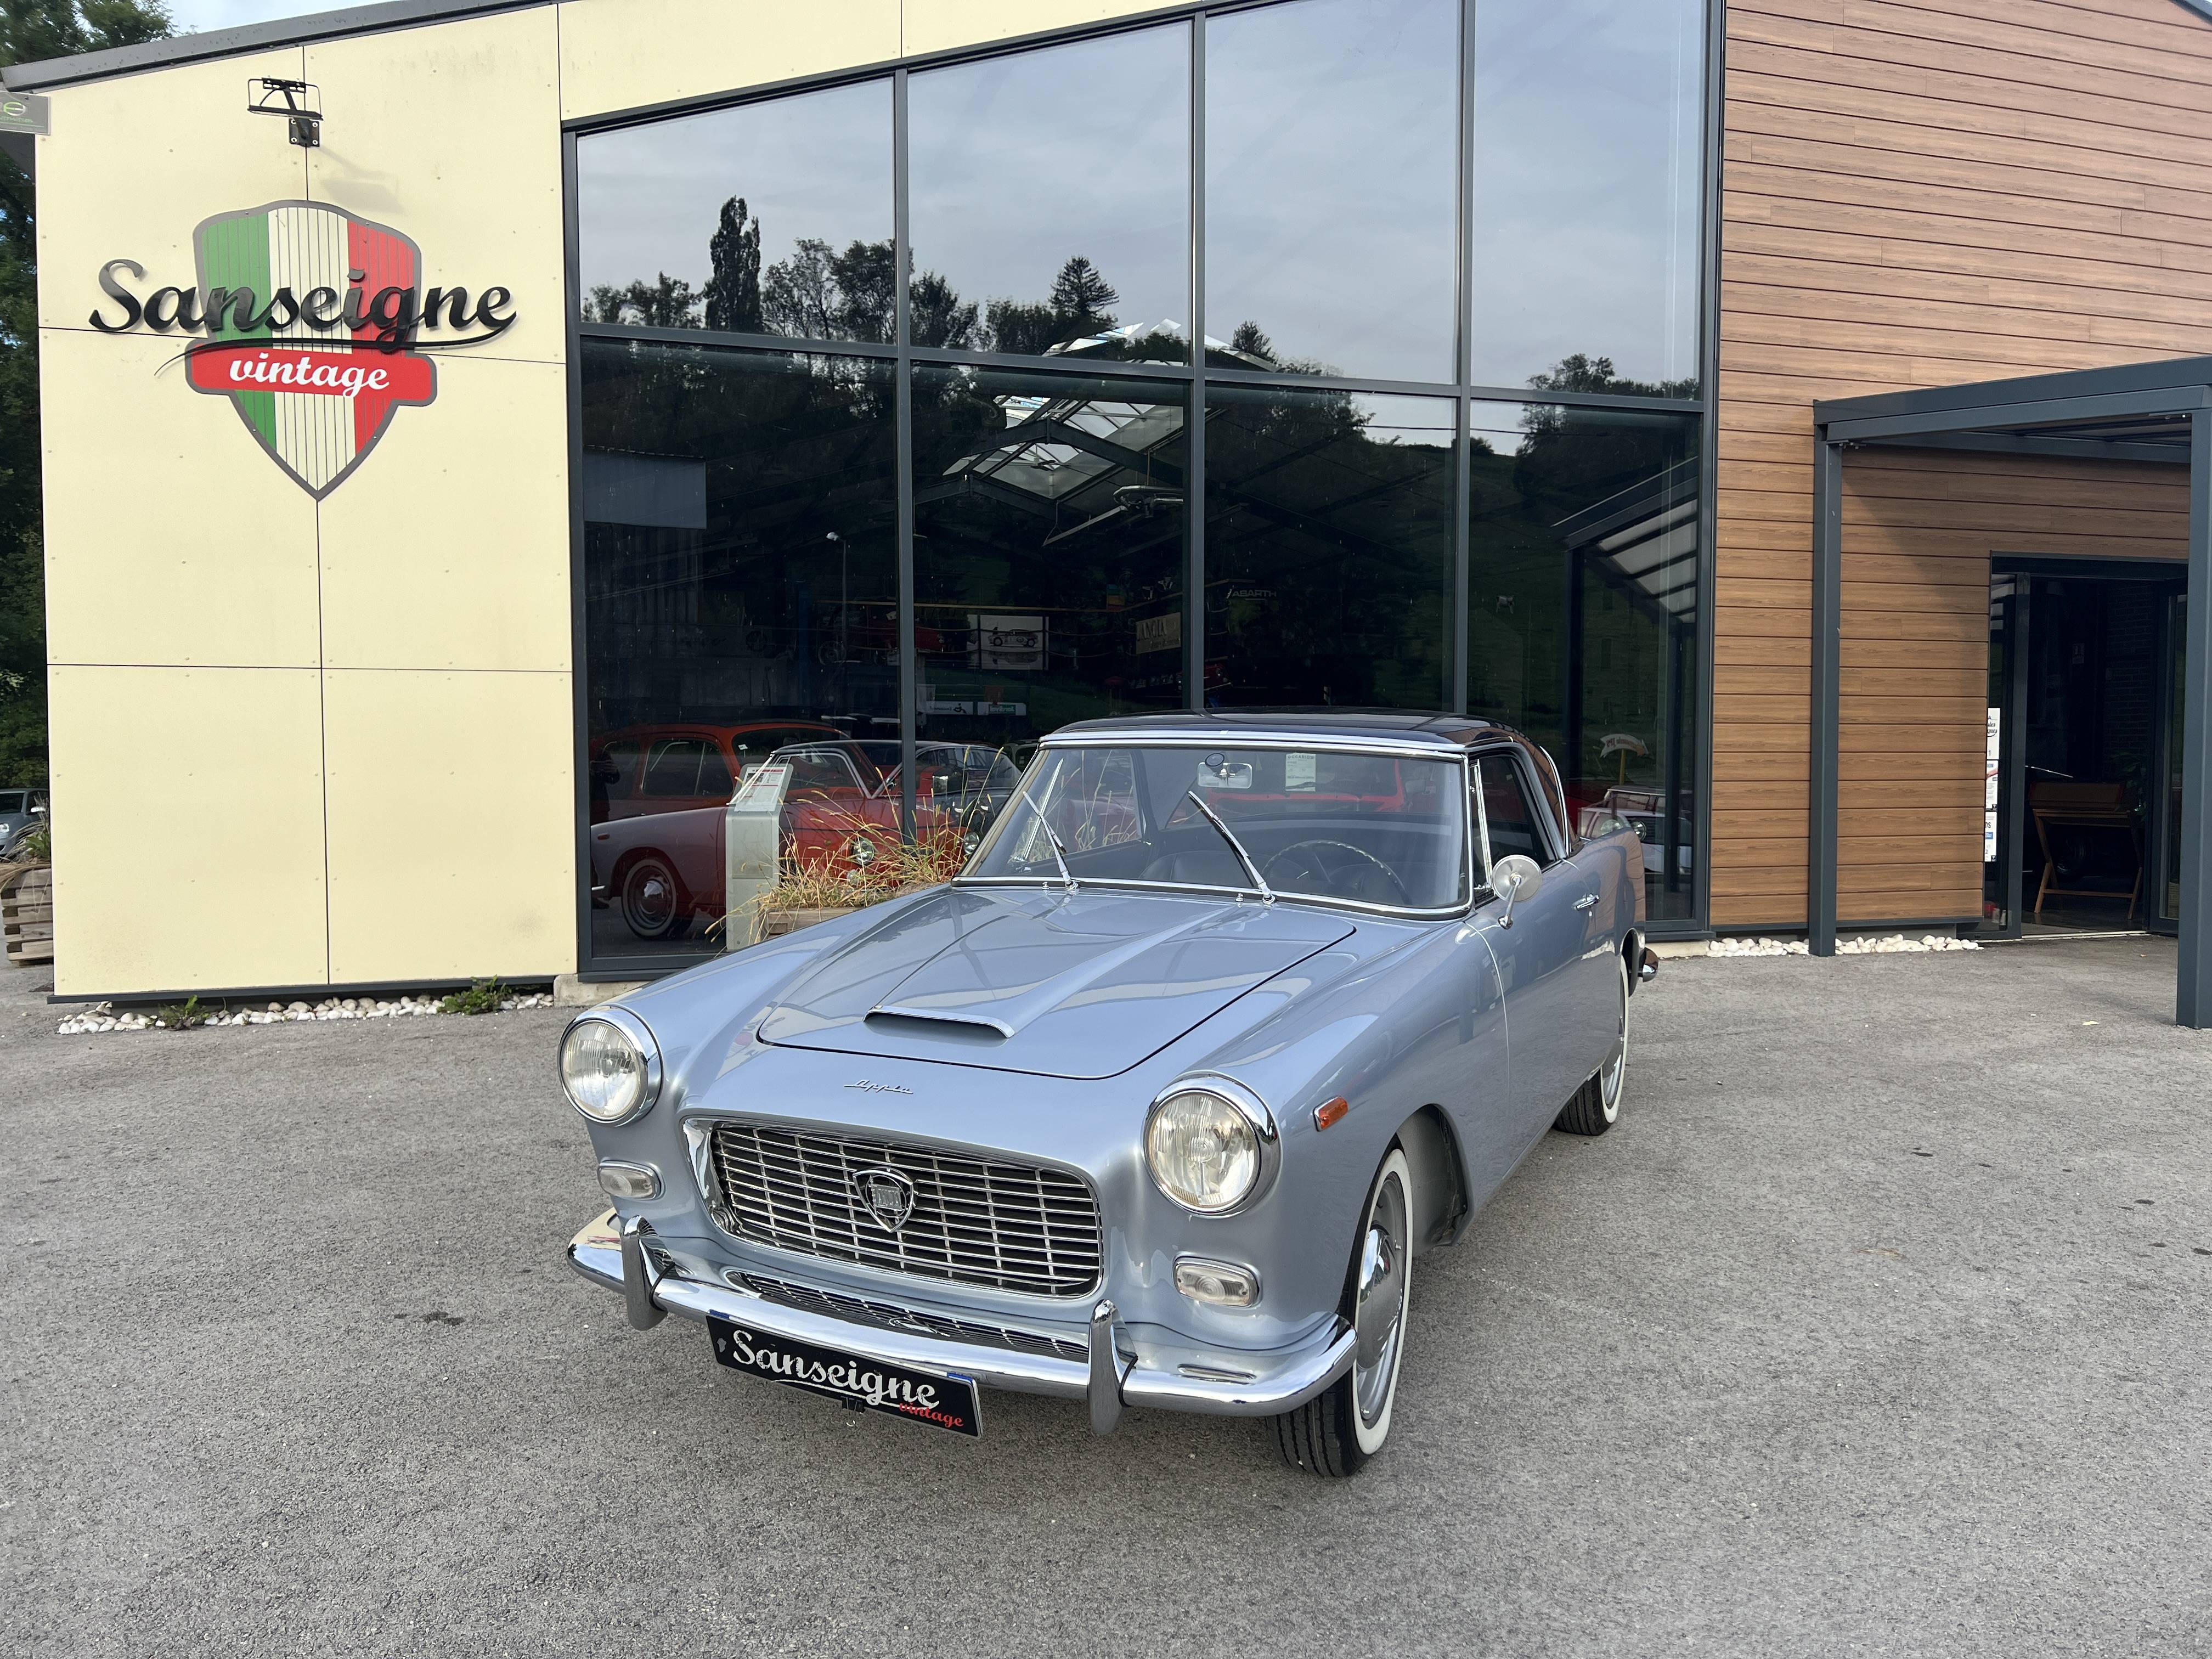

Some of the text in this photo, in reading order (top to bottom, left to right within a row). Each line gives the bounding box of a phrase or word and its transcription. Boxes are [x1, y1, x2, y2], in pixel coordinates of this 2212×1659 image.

[89, 259, 517, 352] Sanseigne
[229, 353, 390, 397] vintage
[1232, 589, 1277, 597] ABARTH
[843, 1079, 914, 1094] Appia
[733, 1329, 940, 1409] Sanseigne
[899, 1402, 964, 1428] vintage
